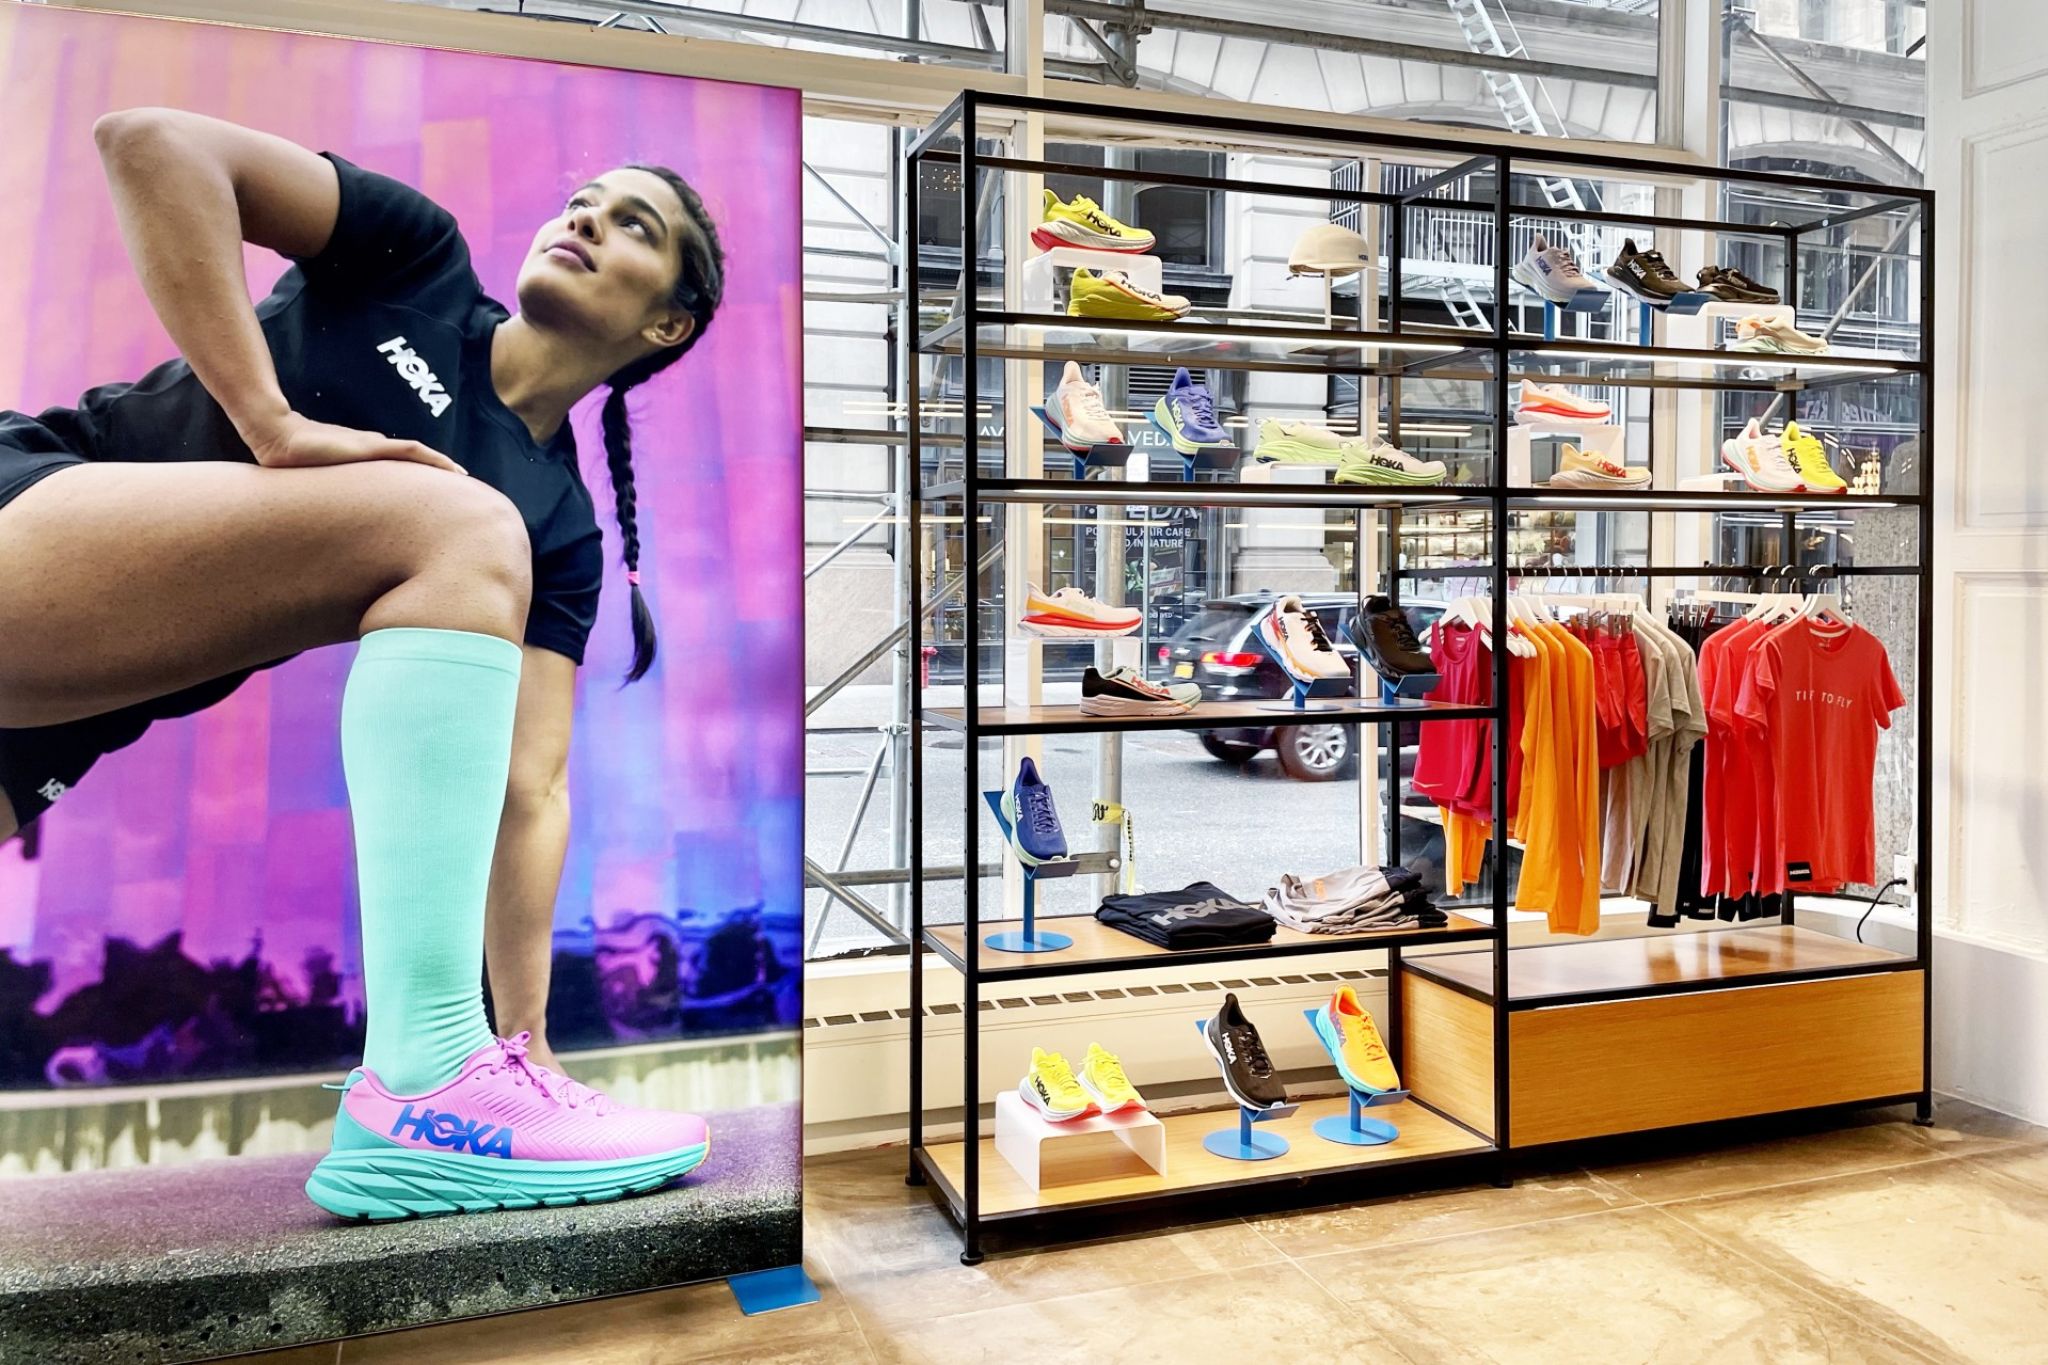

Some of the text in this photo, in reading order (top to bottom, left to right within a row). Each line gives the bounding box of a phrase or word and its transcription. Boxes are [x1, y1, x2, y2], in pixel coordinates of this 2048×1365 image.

[1086, 211, 1122, 238] HOKA
[1628, 258, 1647, 280] HOKA
[1120, 279, 1163, 302] HOKA
[376, 336, 453, 418] HOKA
[1171, 397, 1186, 432] HOKA
[1369, 454, 1405, 472] HOKA
[1597, 459, 1627, 479] HOKA
[1786, 447, 1802, 474] HOKA
[1165, 527, 1191, 537] CARE
[1130, 676, 1171, 696] HOKA
[1821, 691, 1834, 704] TO
[1836, 696, 1853, 709] FLY
[1150, 896, 1243, 927] HOKA
[1222, 1032, 1238, 1065] HOKA
[1034, 1075, 1051, 1107] HOKA
[390, 1103, 514, 1160] HOKA
